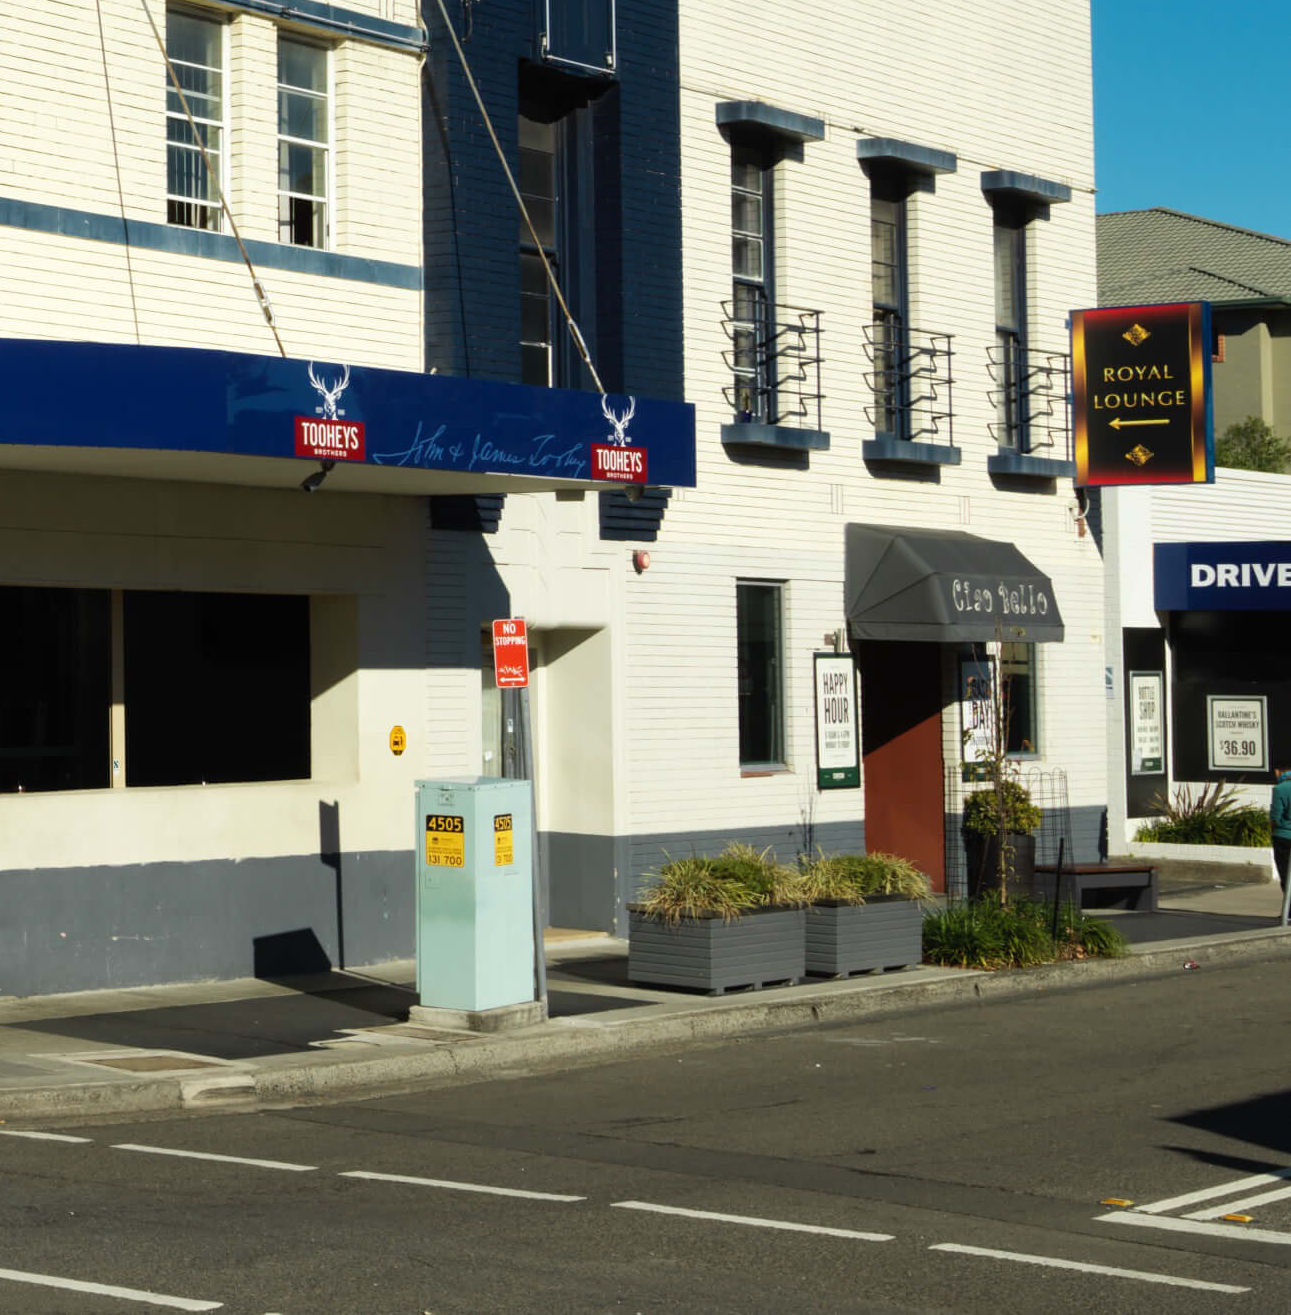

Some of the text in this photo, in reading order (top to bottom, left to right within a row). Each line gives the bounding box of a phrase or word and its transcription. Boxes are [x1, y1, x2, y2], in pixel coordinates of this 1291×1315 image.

[1103, 364, 1174, 383] ROYAL
[1093, 390, 1186, 409] LOUNGE
[300, 421, 360, 451] TOOHEYS
[313, 447, 348, 458] BROTHERS
[595, 448, 644, 473] TOOHEYS
[606, 471, 634, 480] BROTHERS
[1191, 563, 1291, 587] DRIVE
[952, 579, 993, 613] Ciao
[502, 623, 517, 635] NO
[495, 636, 527, 646] STOPPING
[822, 671, 849, 695] HAPPY
[824, 696, 850, 724] HOUR
[1219, 740, 1256, 756] $36.90
[428, 816, 462, 832] 4505
[495, 816, 511, 830] 4505
[444, 855, 462, 866] 700
